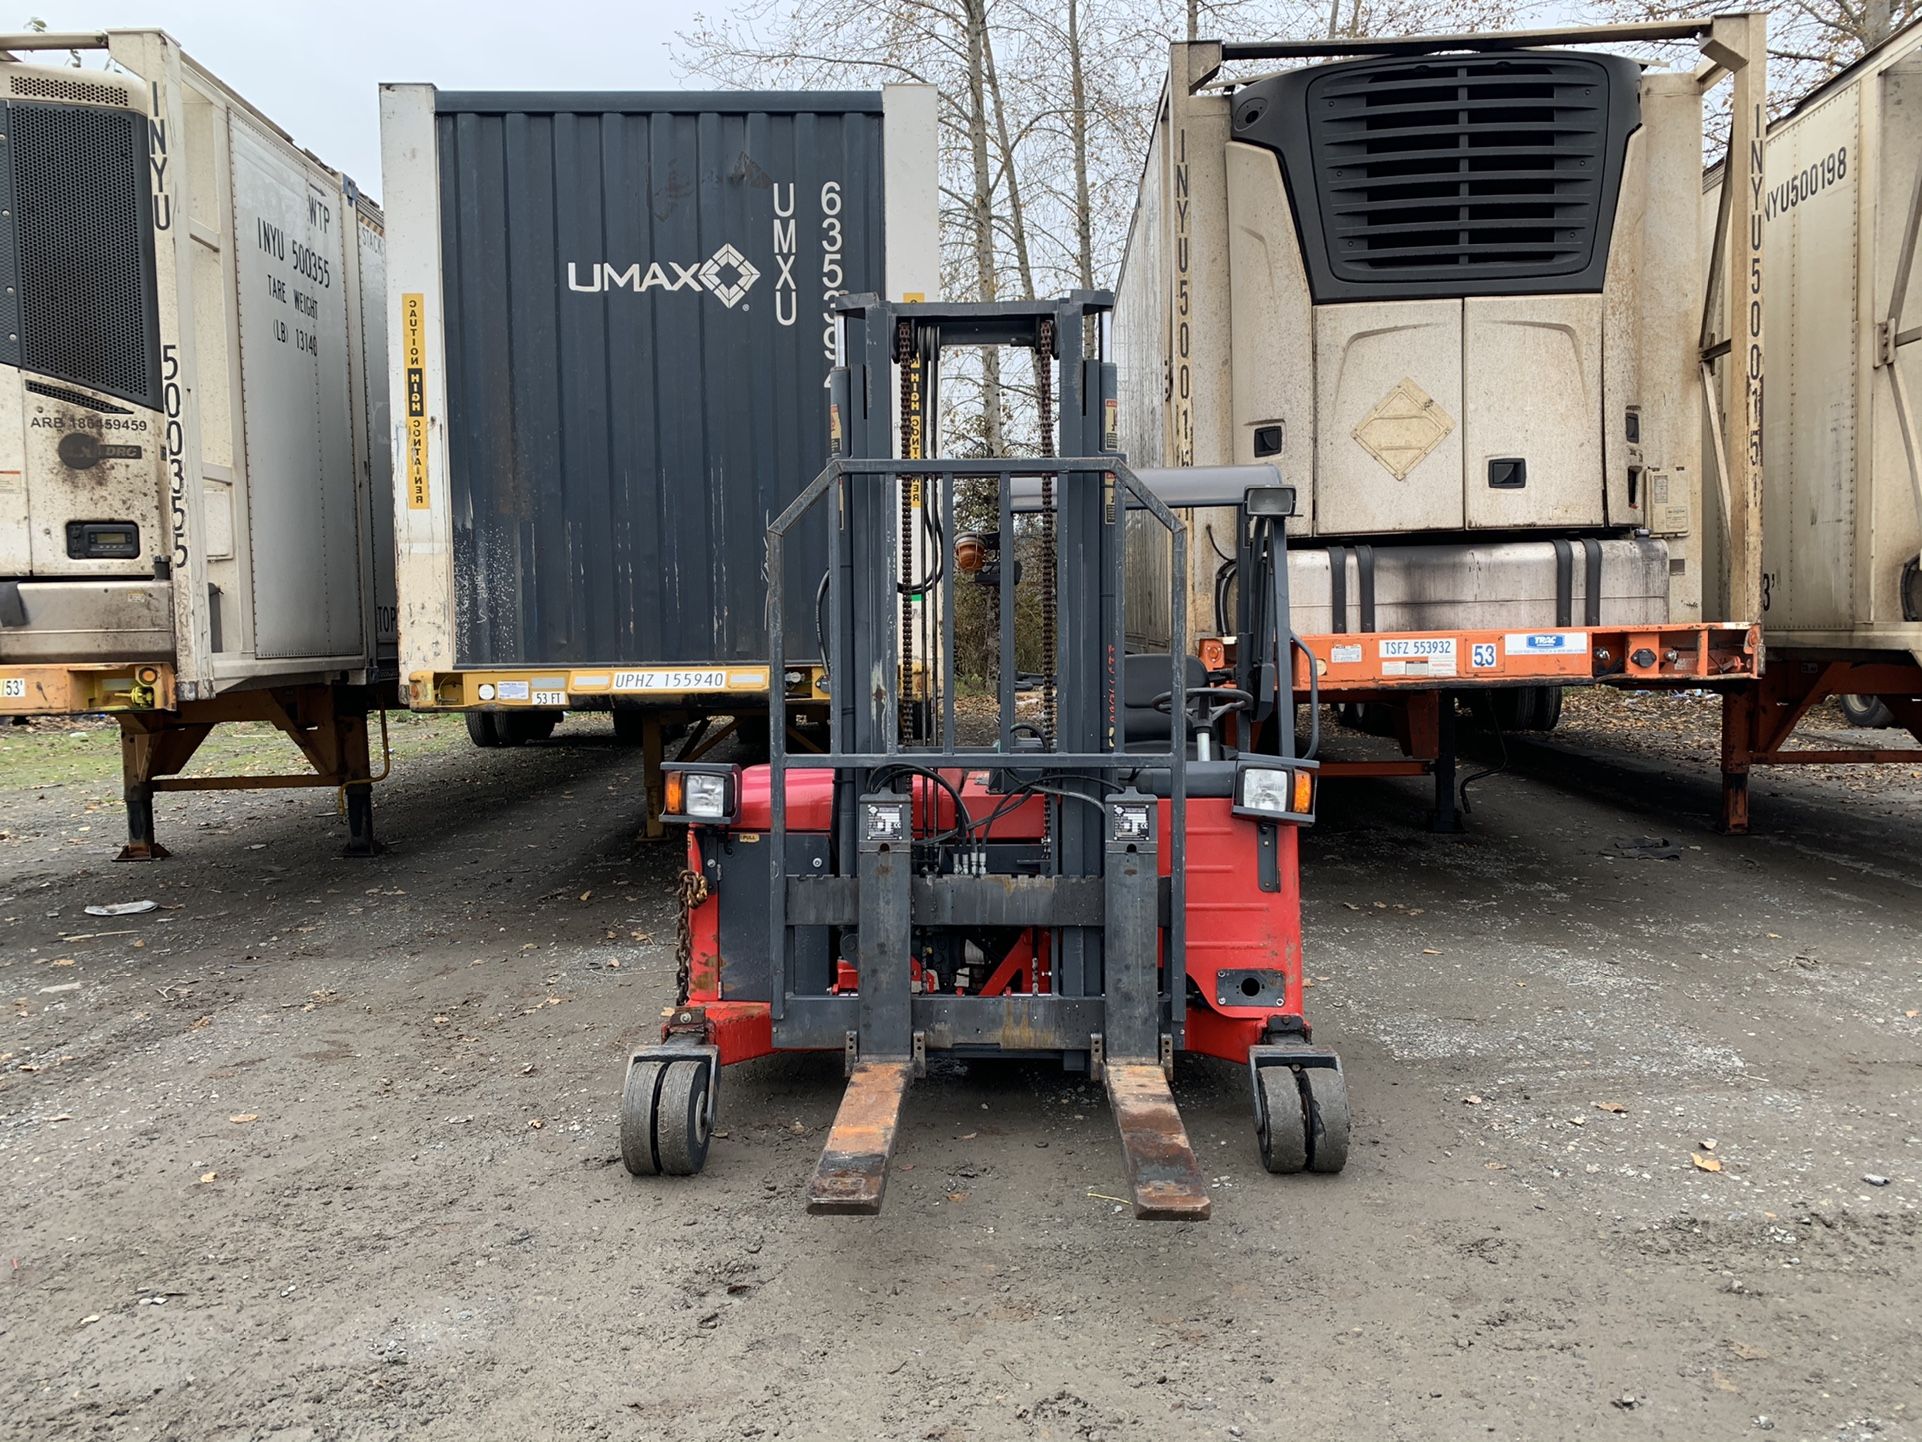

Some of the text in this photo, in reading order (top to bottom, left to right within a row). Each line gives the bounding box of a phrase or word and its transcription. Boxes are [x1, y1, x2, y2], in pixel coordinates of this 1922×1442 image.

[307, 195, 330, 234] WTP
[257, 216, 330, 288] INYU 500355
[773, 182, 797, 326] UMXU
[568, 262, 704, 292] UMAX
[820, 181, 843, 388] 63539
[267, 274, 318, 320] TARE WEIGHT
[149, 81, 188, 568] INYU 500355
[1176, 129, 1192, 520] INYU5001
[30, 417, 65, 429] ARB
[377, 606, 397, 632] TOP
[1385, 640, 1451, 655] TSFZ 553932
[1473, 645, 1495, 666] 53
[615, 672, 724, 688] UPHZ 155940
[536, 692, 561, 705] 53 FT
